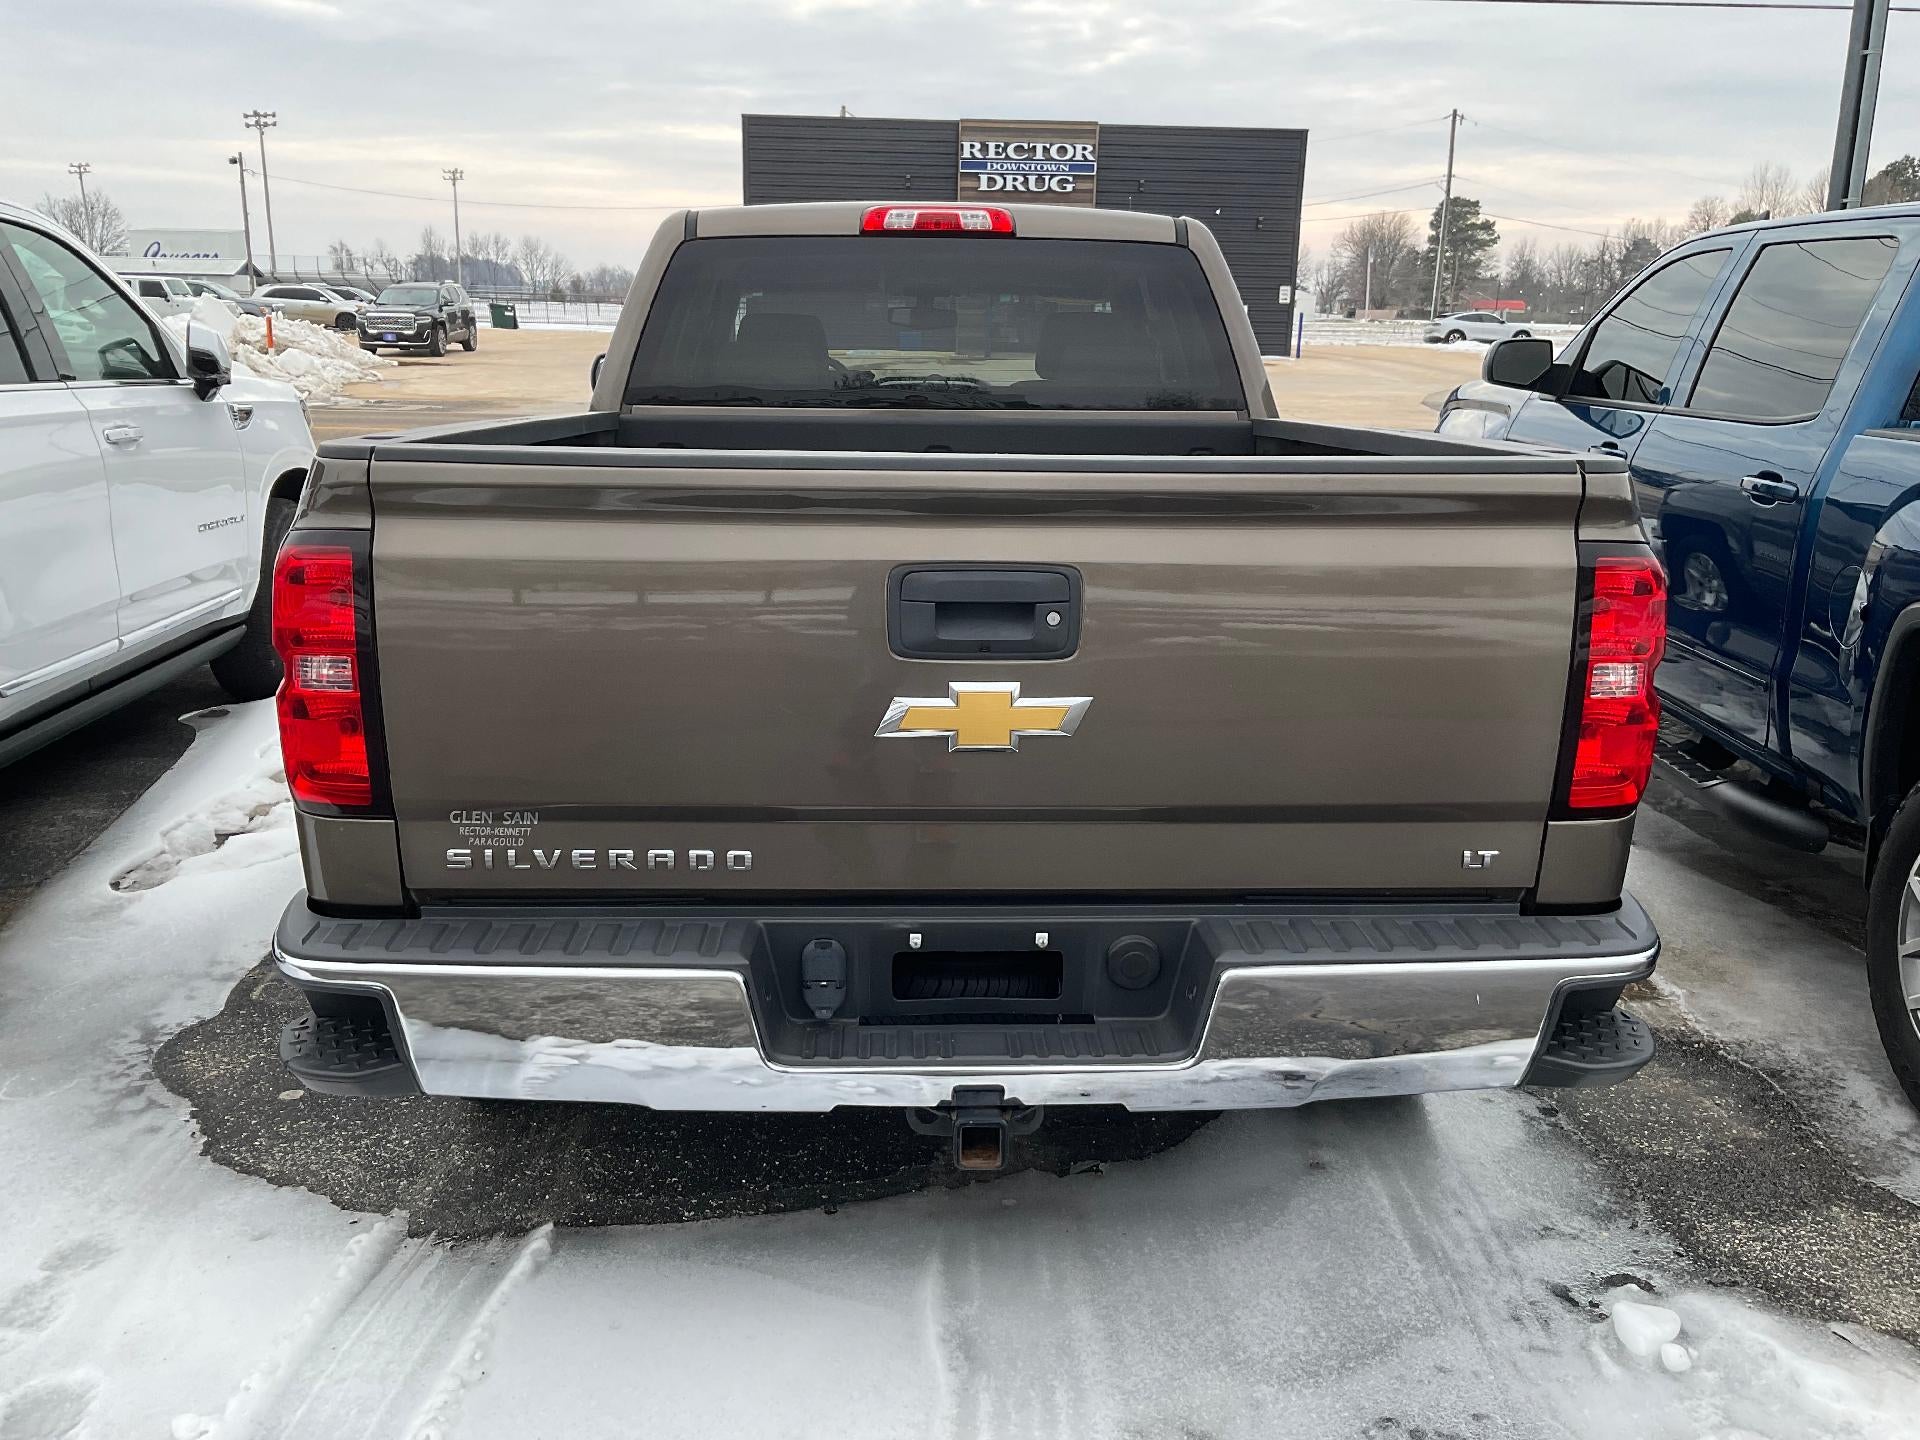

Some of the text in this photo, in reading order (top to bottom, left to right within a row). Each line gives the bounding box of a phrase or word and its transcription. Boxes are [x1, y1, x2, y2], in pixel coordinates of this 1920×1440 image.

[961, 141, 1096, 160] RECTOR
[986, 162, 1070, 172] DOWNTOWN
[977, 174, 1076, 193] DRUG
[449, 810, 539, 825] GLEN SAIN
[459, 826, 532, 837] RECTOR-KENNETT
[468, 837, 525, 847] PARAGOULD
[446, 848, 753, 871] SILVERADO
[1462, 850, 1500, 869] LT
